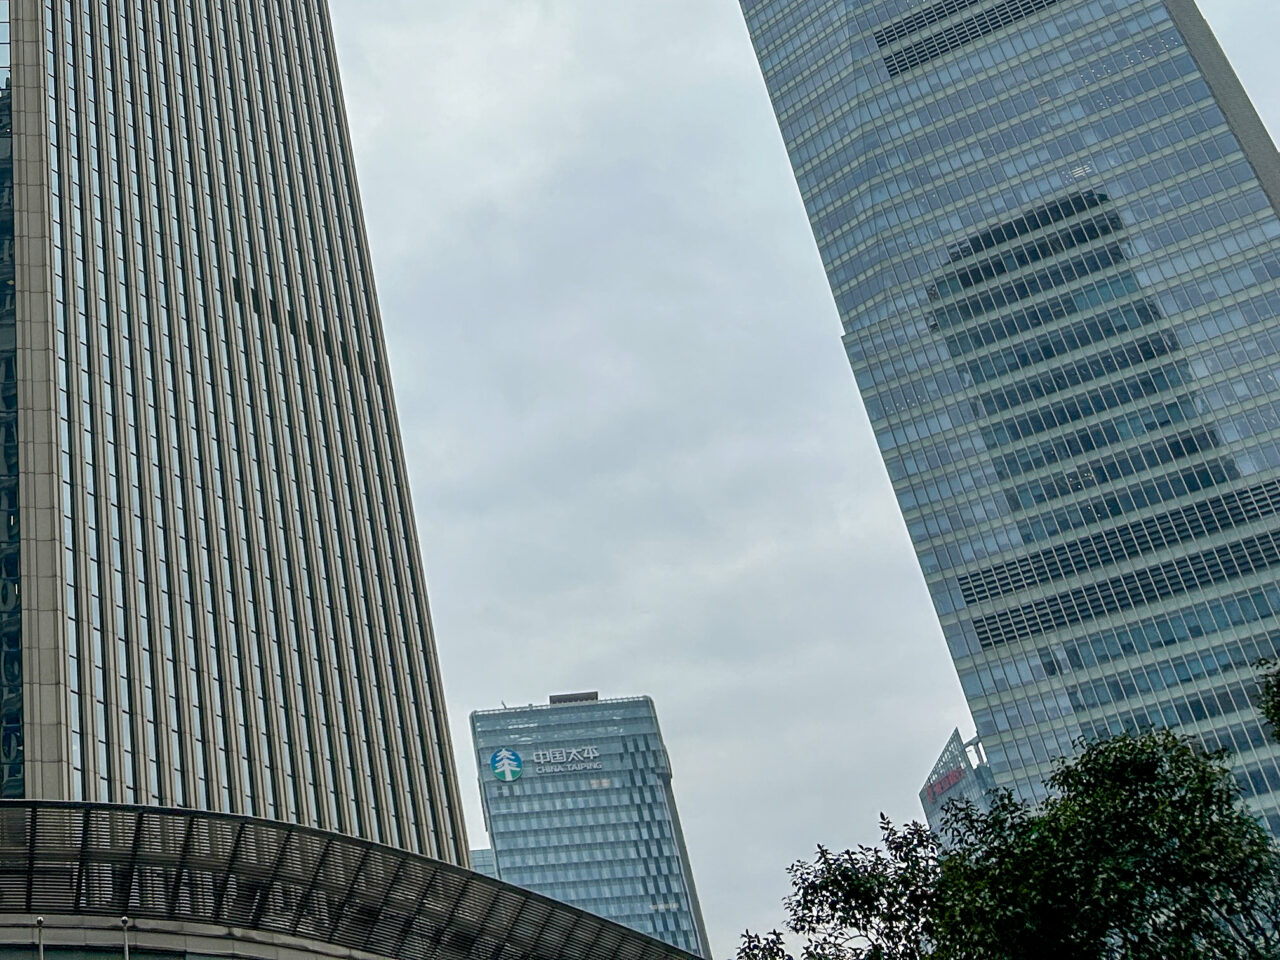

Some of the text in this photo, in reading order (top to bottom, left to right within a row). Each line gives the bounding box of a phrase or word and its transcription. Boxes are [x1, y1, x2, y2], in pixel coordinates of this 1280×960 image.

[533, 745, 600, 764] 中国太平
[536, 761, 602, 774] CHINA TAIPING
